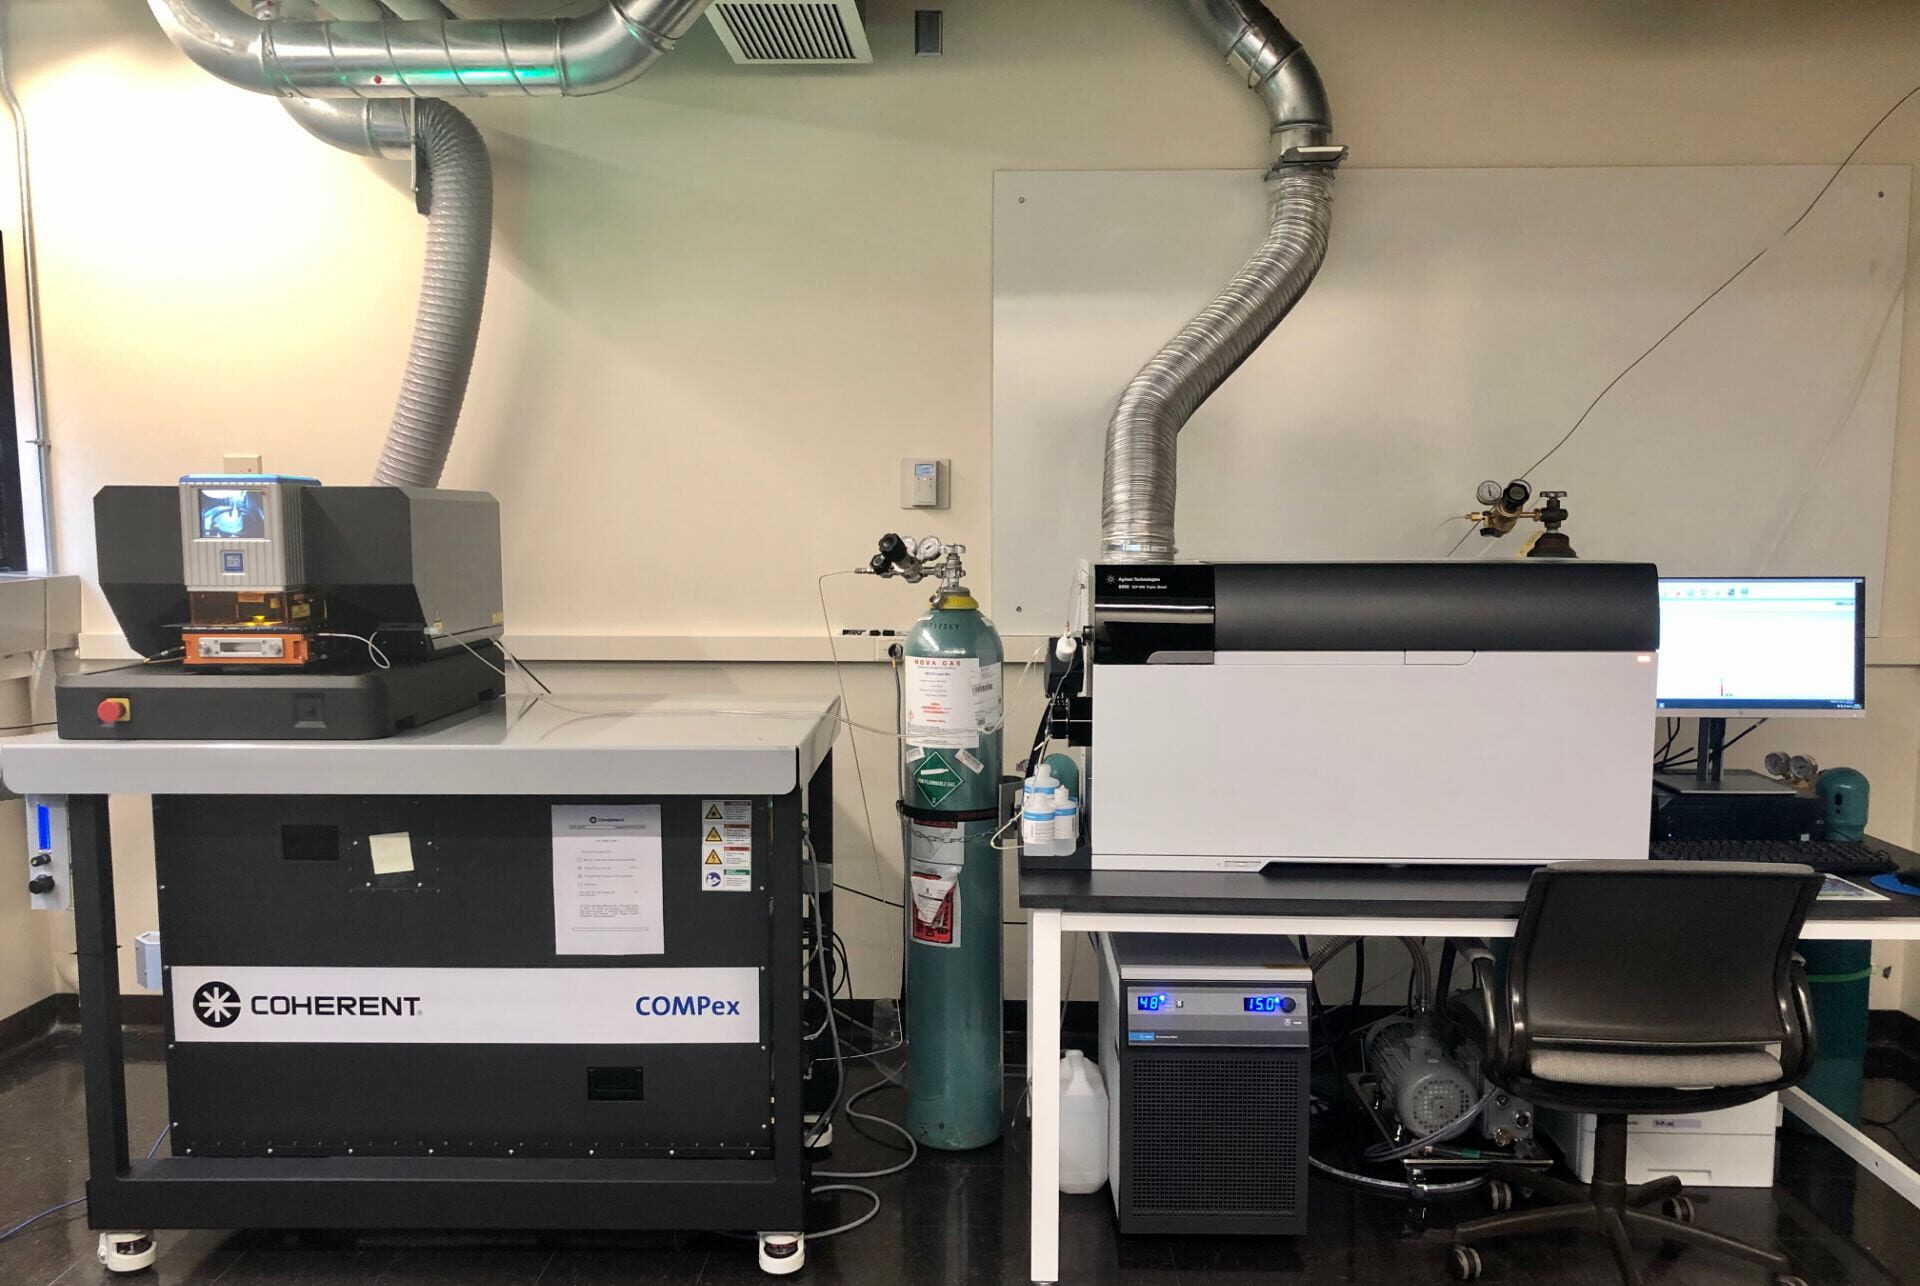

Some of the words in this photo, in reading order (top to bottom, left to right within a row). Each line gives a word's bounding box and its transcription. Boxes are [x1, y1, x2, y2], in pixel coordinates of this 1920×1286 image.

[250, 995, 421, 1017] COHERENT
[635, 995, 740, 1017] COMPex
[1140, 996, 1158, 1010] 48
